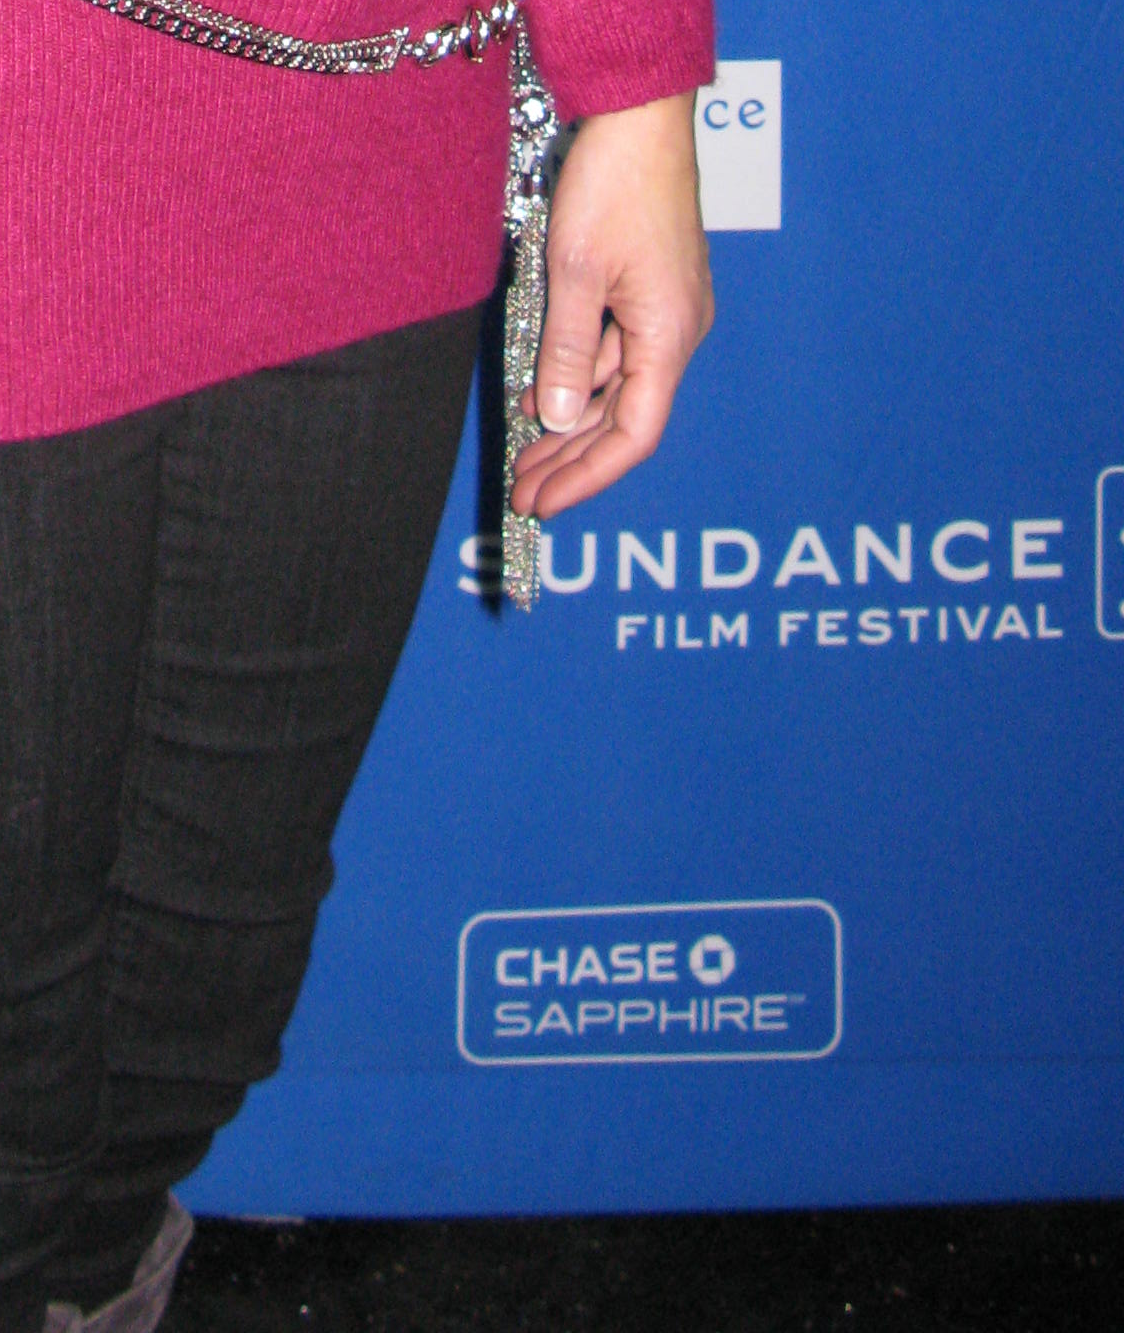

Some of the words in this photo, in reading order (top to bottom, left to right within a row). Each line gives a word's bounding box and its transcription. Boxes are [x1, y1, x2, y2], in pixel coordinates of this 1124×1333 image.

[458, 520, 1063, 593] SUNDANCE
[617, 614, 749, 649] FILM
[779, 605, 1063, 646] FESTIVAL
[495, 942, 678, 986] CHASE
[495, 994, 788, 1037] SAPPHIRE
